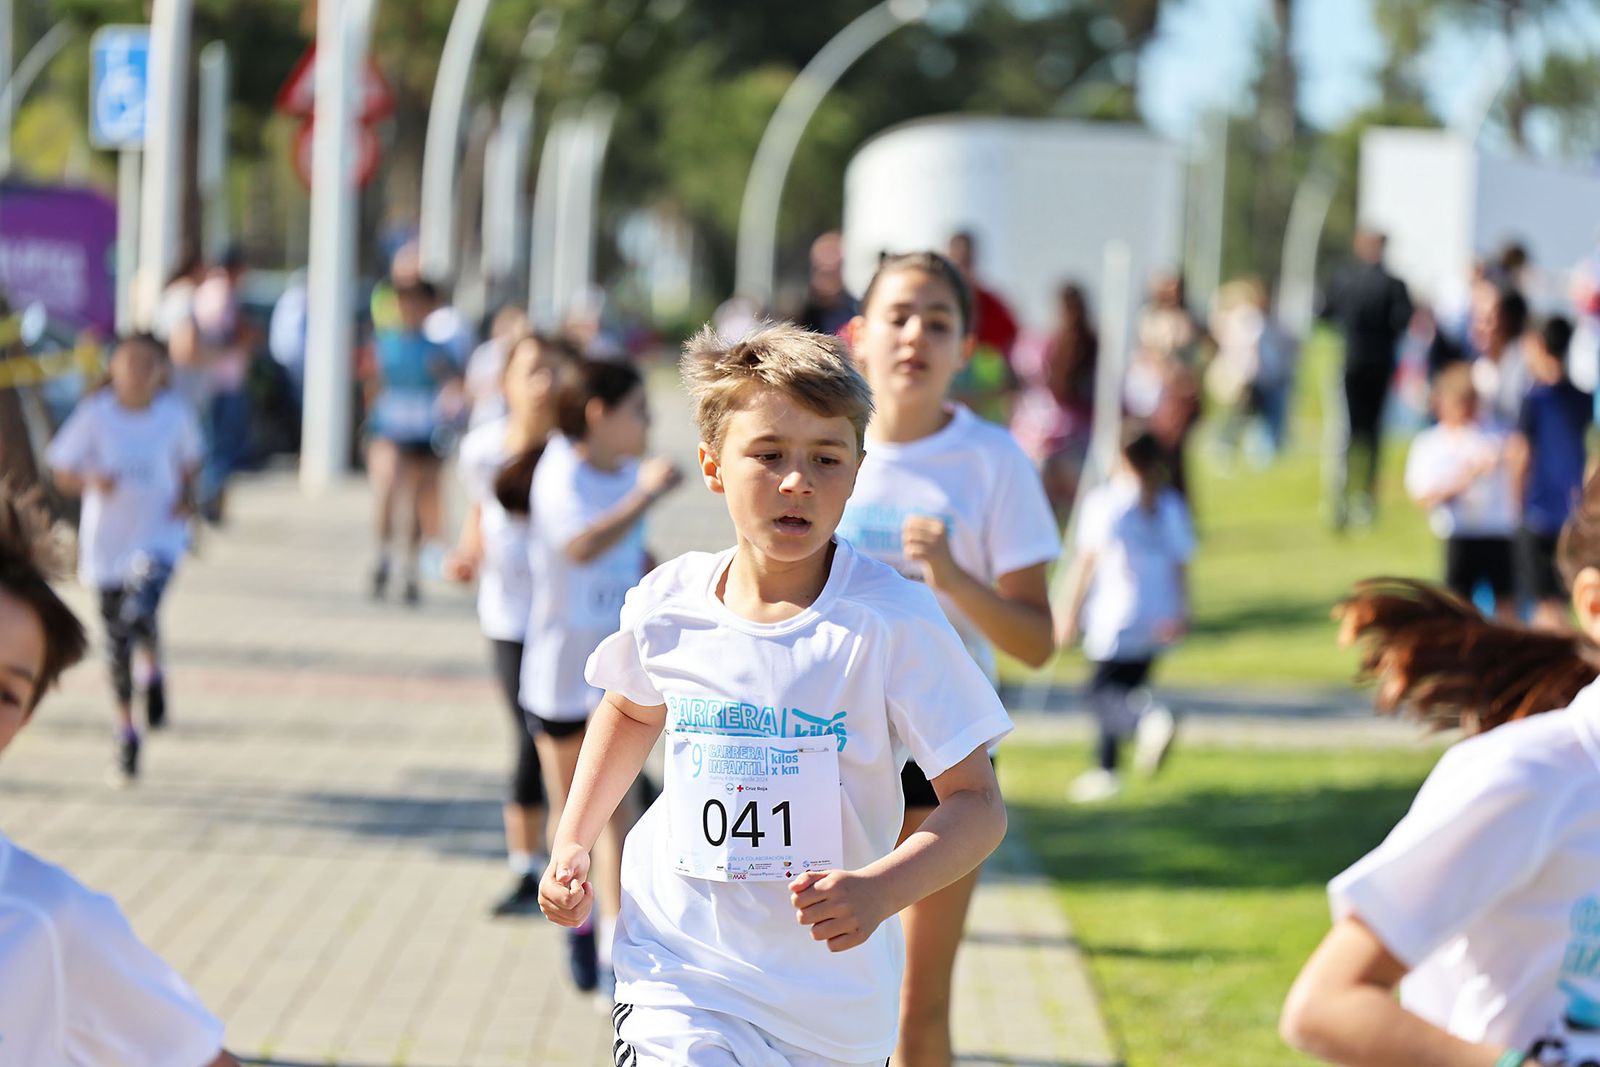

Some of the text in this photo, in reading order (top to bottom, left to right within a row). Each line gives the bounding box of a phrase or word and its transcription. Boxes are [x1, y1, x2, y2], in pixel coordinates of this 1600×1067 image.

[667, 697, 778, 735] CARRERA
[708, 744, 765, 760] CARRERA
[771, 753, 799, 764] kilos
[709, 760, 766, 776] INFANTIL
[781, 765, 799, 775] km
[703, 799, 792, 848] 041
